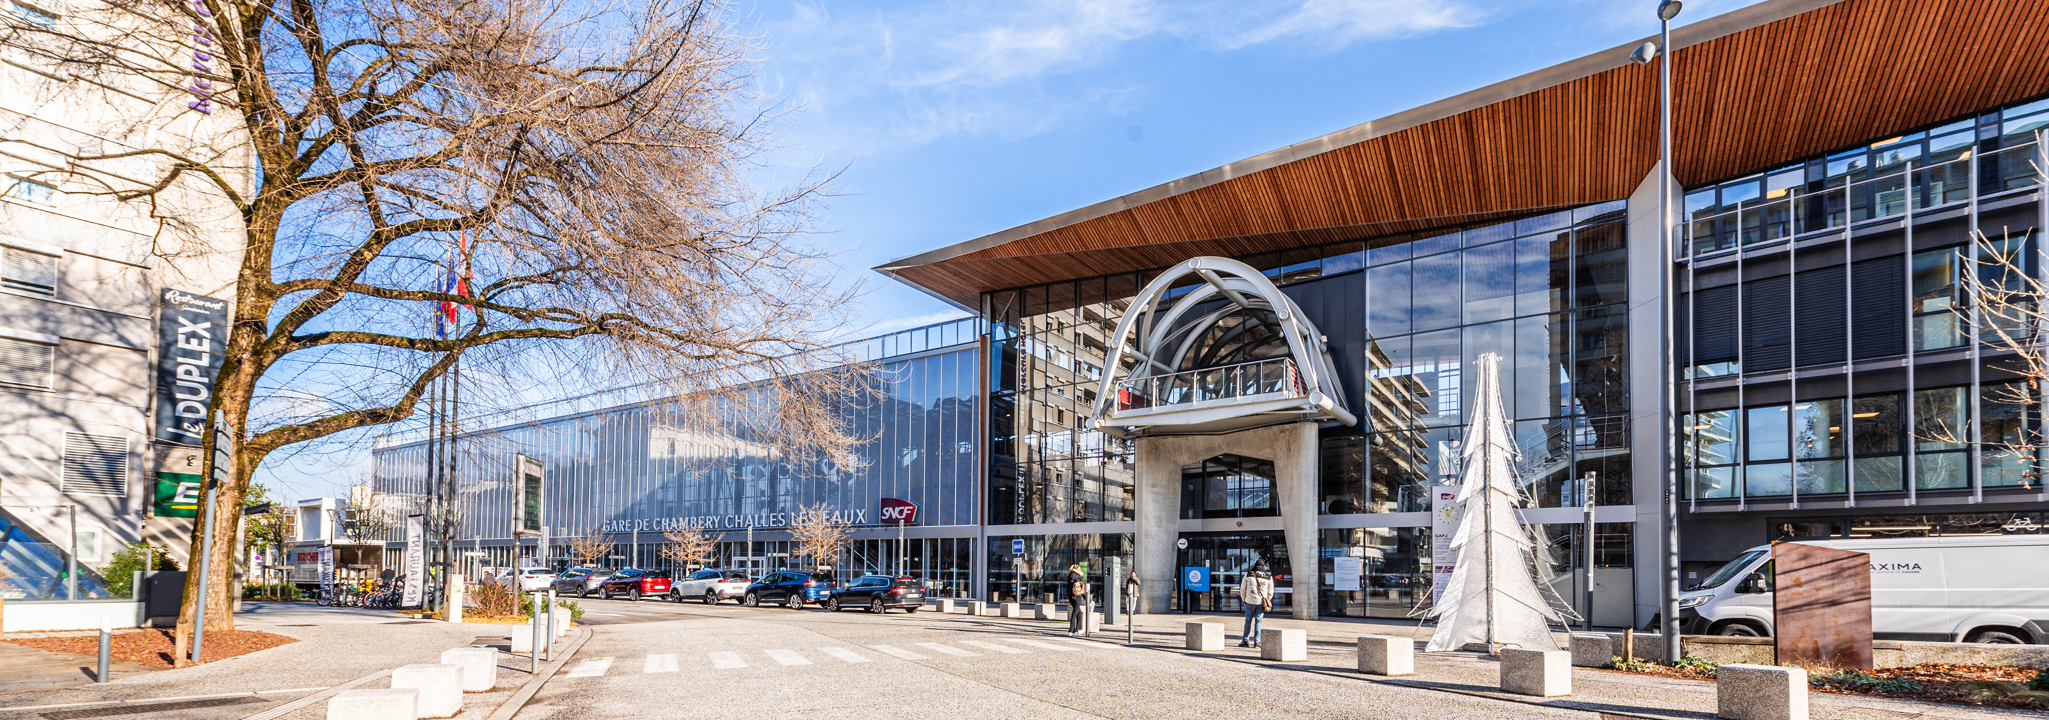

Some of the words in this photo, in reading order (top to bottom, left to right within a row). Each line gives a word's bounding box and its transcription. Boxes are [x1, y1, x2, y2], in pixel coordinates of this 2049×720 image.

[175, 315, 211, 420] DUPLEX
[603, 520, 632, 532] GARE
[635, 518, 650, 531] DE
[653, 515, 721, 531] CHAMBERY
[725, 512, 786, 528] CHALLES
[791, 510, 816, 526] LES
[822, 508, 866, 525] EAUX
[881, 506, 913, 520] SNCF
